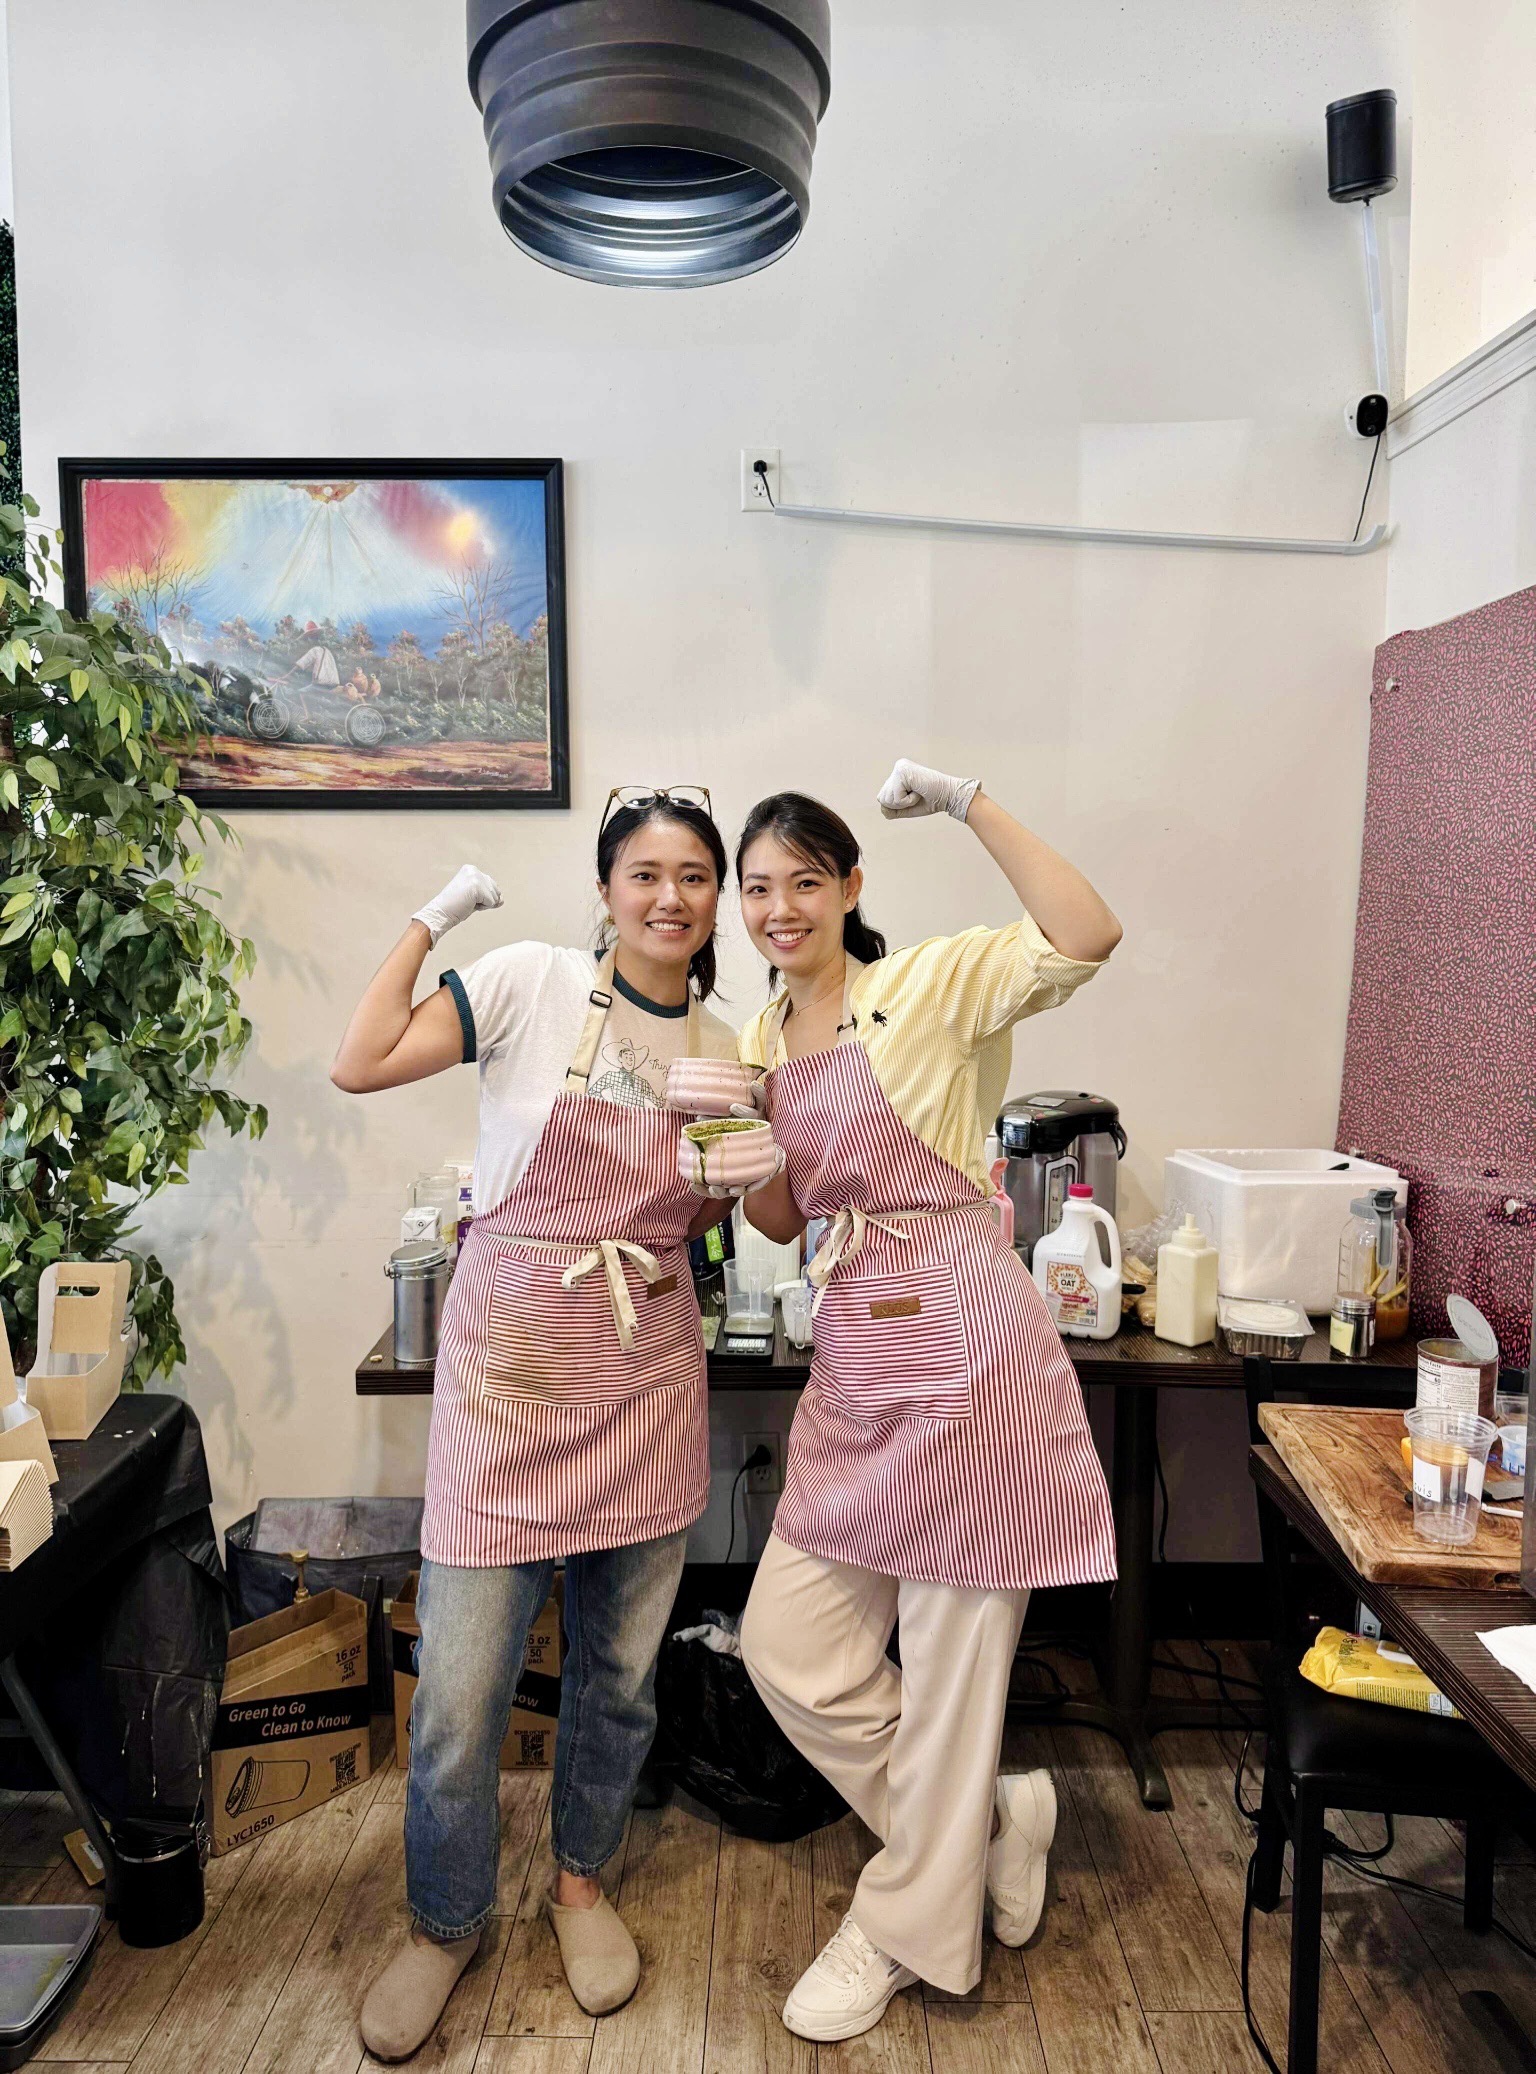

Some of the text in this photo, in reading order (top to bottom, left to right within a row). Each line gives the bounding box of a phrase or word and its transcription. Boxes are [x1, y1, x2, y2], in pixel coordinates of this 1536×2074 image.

[1060, 1279, 1076, 1287] OAT
[538, 1636, 551, 1645] oz
[336, 1645, 361, 1664] 16 oz
[530, 1648, 542, 1657] 50
[343, 1661, 354, 1673] 50
[341, 1671, 356, 1683] pack
[512, 1692, 538, 1707] now
[229, 1701, 306, 1722] Green to Go
[261, 1714, 352, 1737] Clean to Know
[227, 1814, 275, 1847] LYC1650
